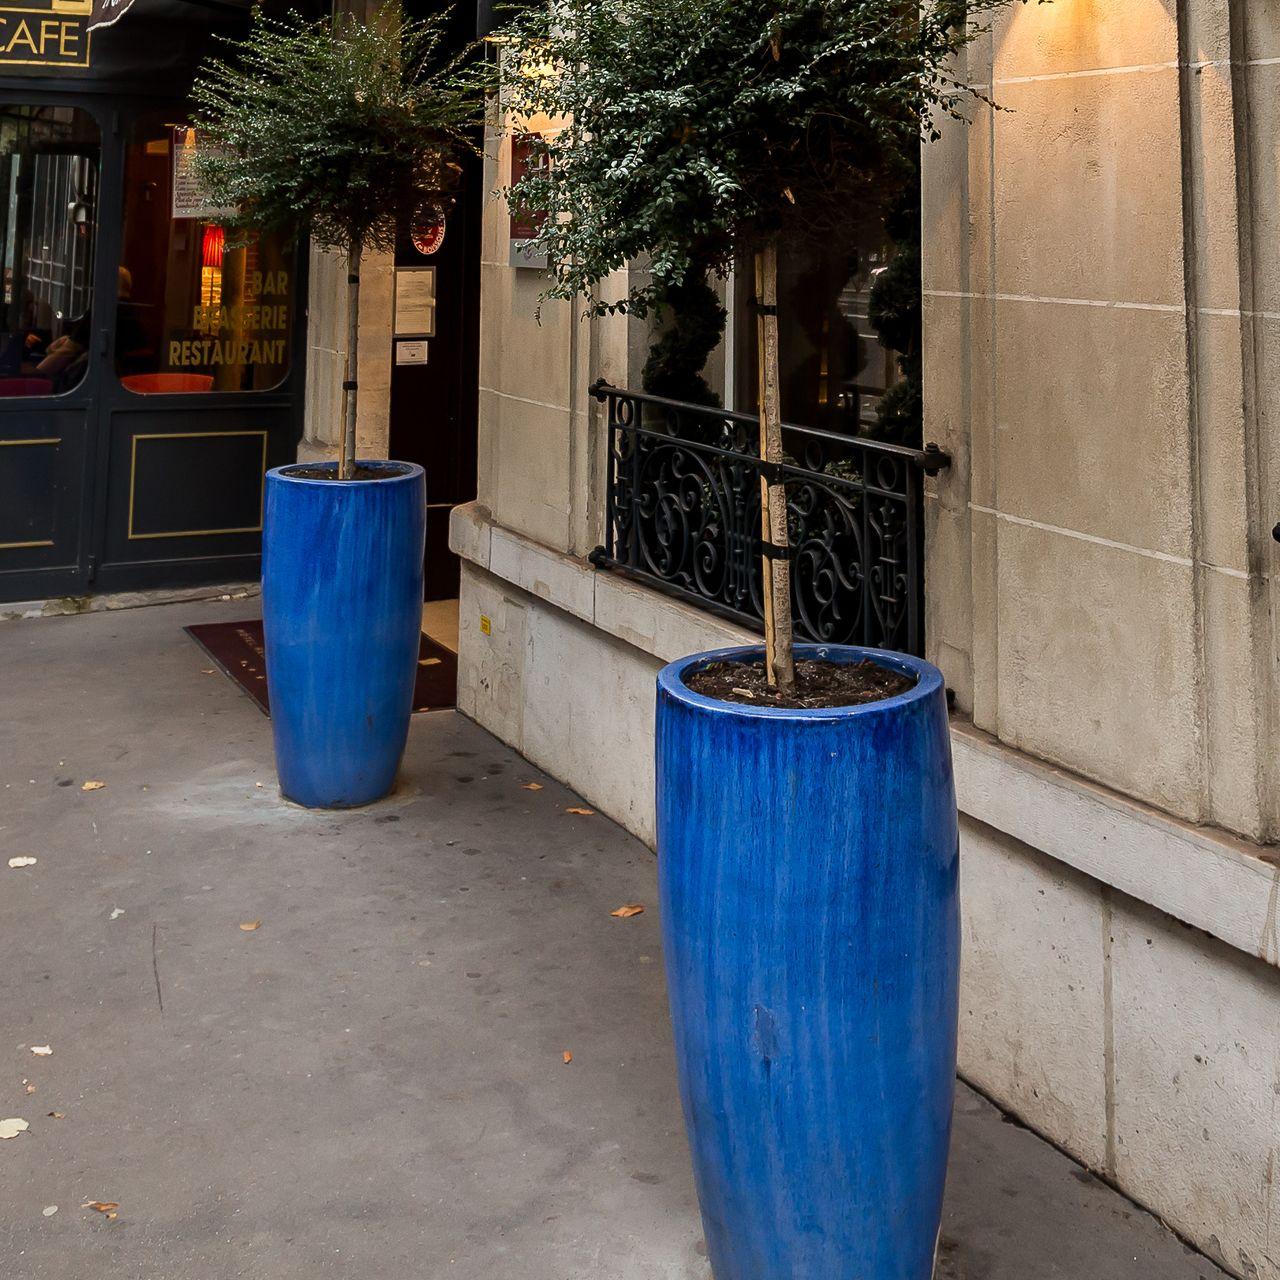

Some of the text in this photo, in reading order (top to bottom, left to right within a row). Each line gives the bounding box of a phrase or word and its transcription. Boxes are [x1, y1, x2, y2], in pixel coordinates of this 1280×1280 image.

[252, 270, 288, 296] BAR
[192, 304, 288, 331] BRASSERIE
[168, 339, 287, 367] RESTAURANT
